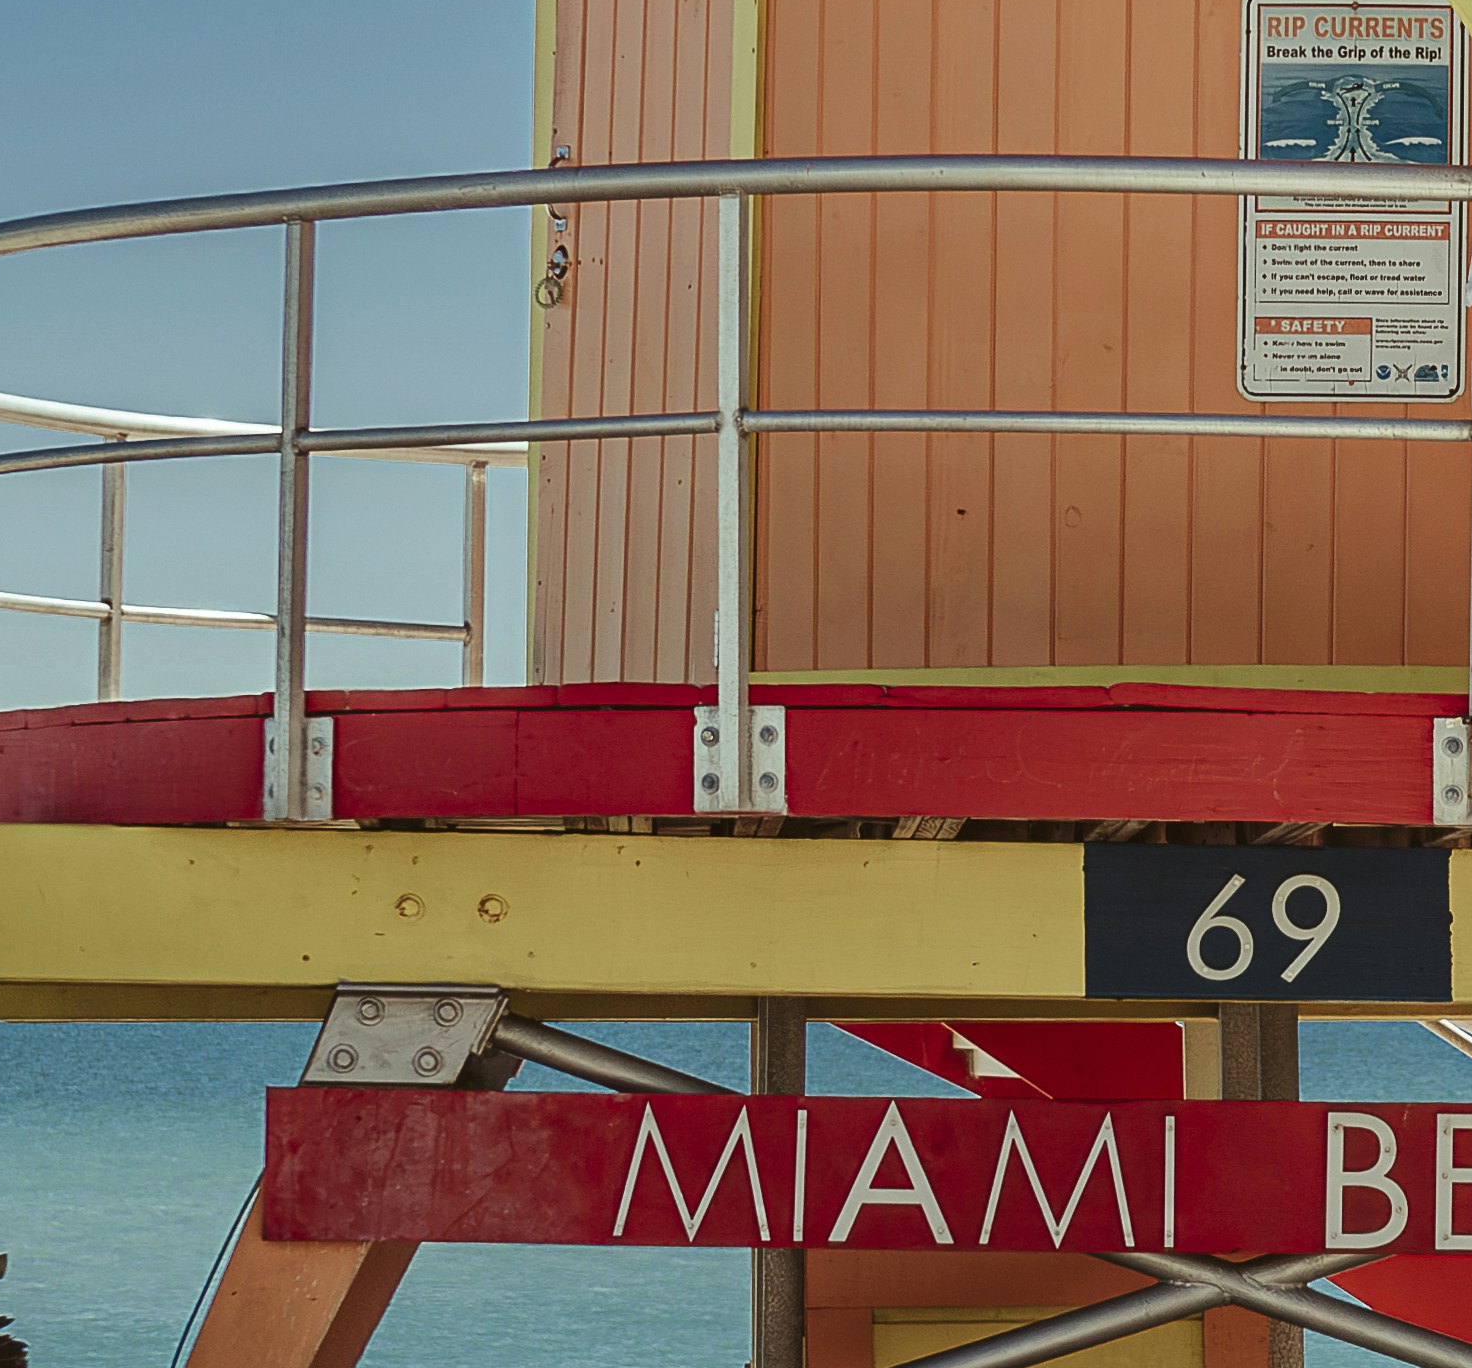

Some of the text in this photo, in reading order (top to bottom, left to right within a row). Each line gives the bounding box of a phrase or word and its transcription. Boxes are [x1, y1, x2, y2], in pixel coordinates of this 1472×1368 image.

[1266, 16, 1444, 39] RIP CURRENTS
[1266, 45, 1442, 62] Break the Grip of the Rip!
[1261, 224, 1444, 237] IF CAUGHT IN A RIP CURRENT
[1294, 244, 1312, 253] fight
[1314, 244, 1327, 252] the
[1329, 244, 1358, 252] current
[1334, 259, 1367, 268] current,
[1271, 273, 1277, 281] If
[1279, 275, 1293, 283] you
[1295, 273, 1315, 281] can't
[1317, 274, 1348, 283] escape,
[1350, 273, 1368, 282] float
[1380, 274, 1400, 282] tread
[1279, 289, 1293, 297] you
[1295, 288, 1315, 296] need
[1316, 288, 1336, 297] help,
[1400, 289, 1442, 297] assistance
[1280, 319, 1345, 332] SAFETY
[1290, 365, 1315, 373] doubt,
[1184, 873, 1341, 983] 69
[613, 1101, 1178, 1250] MIAMI
